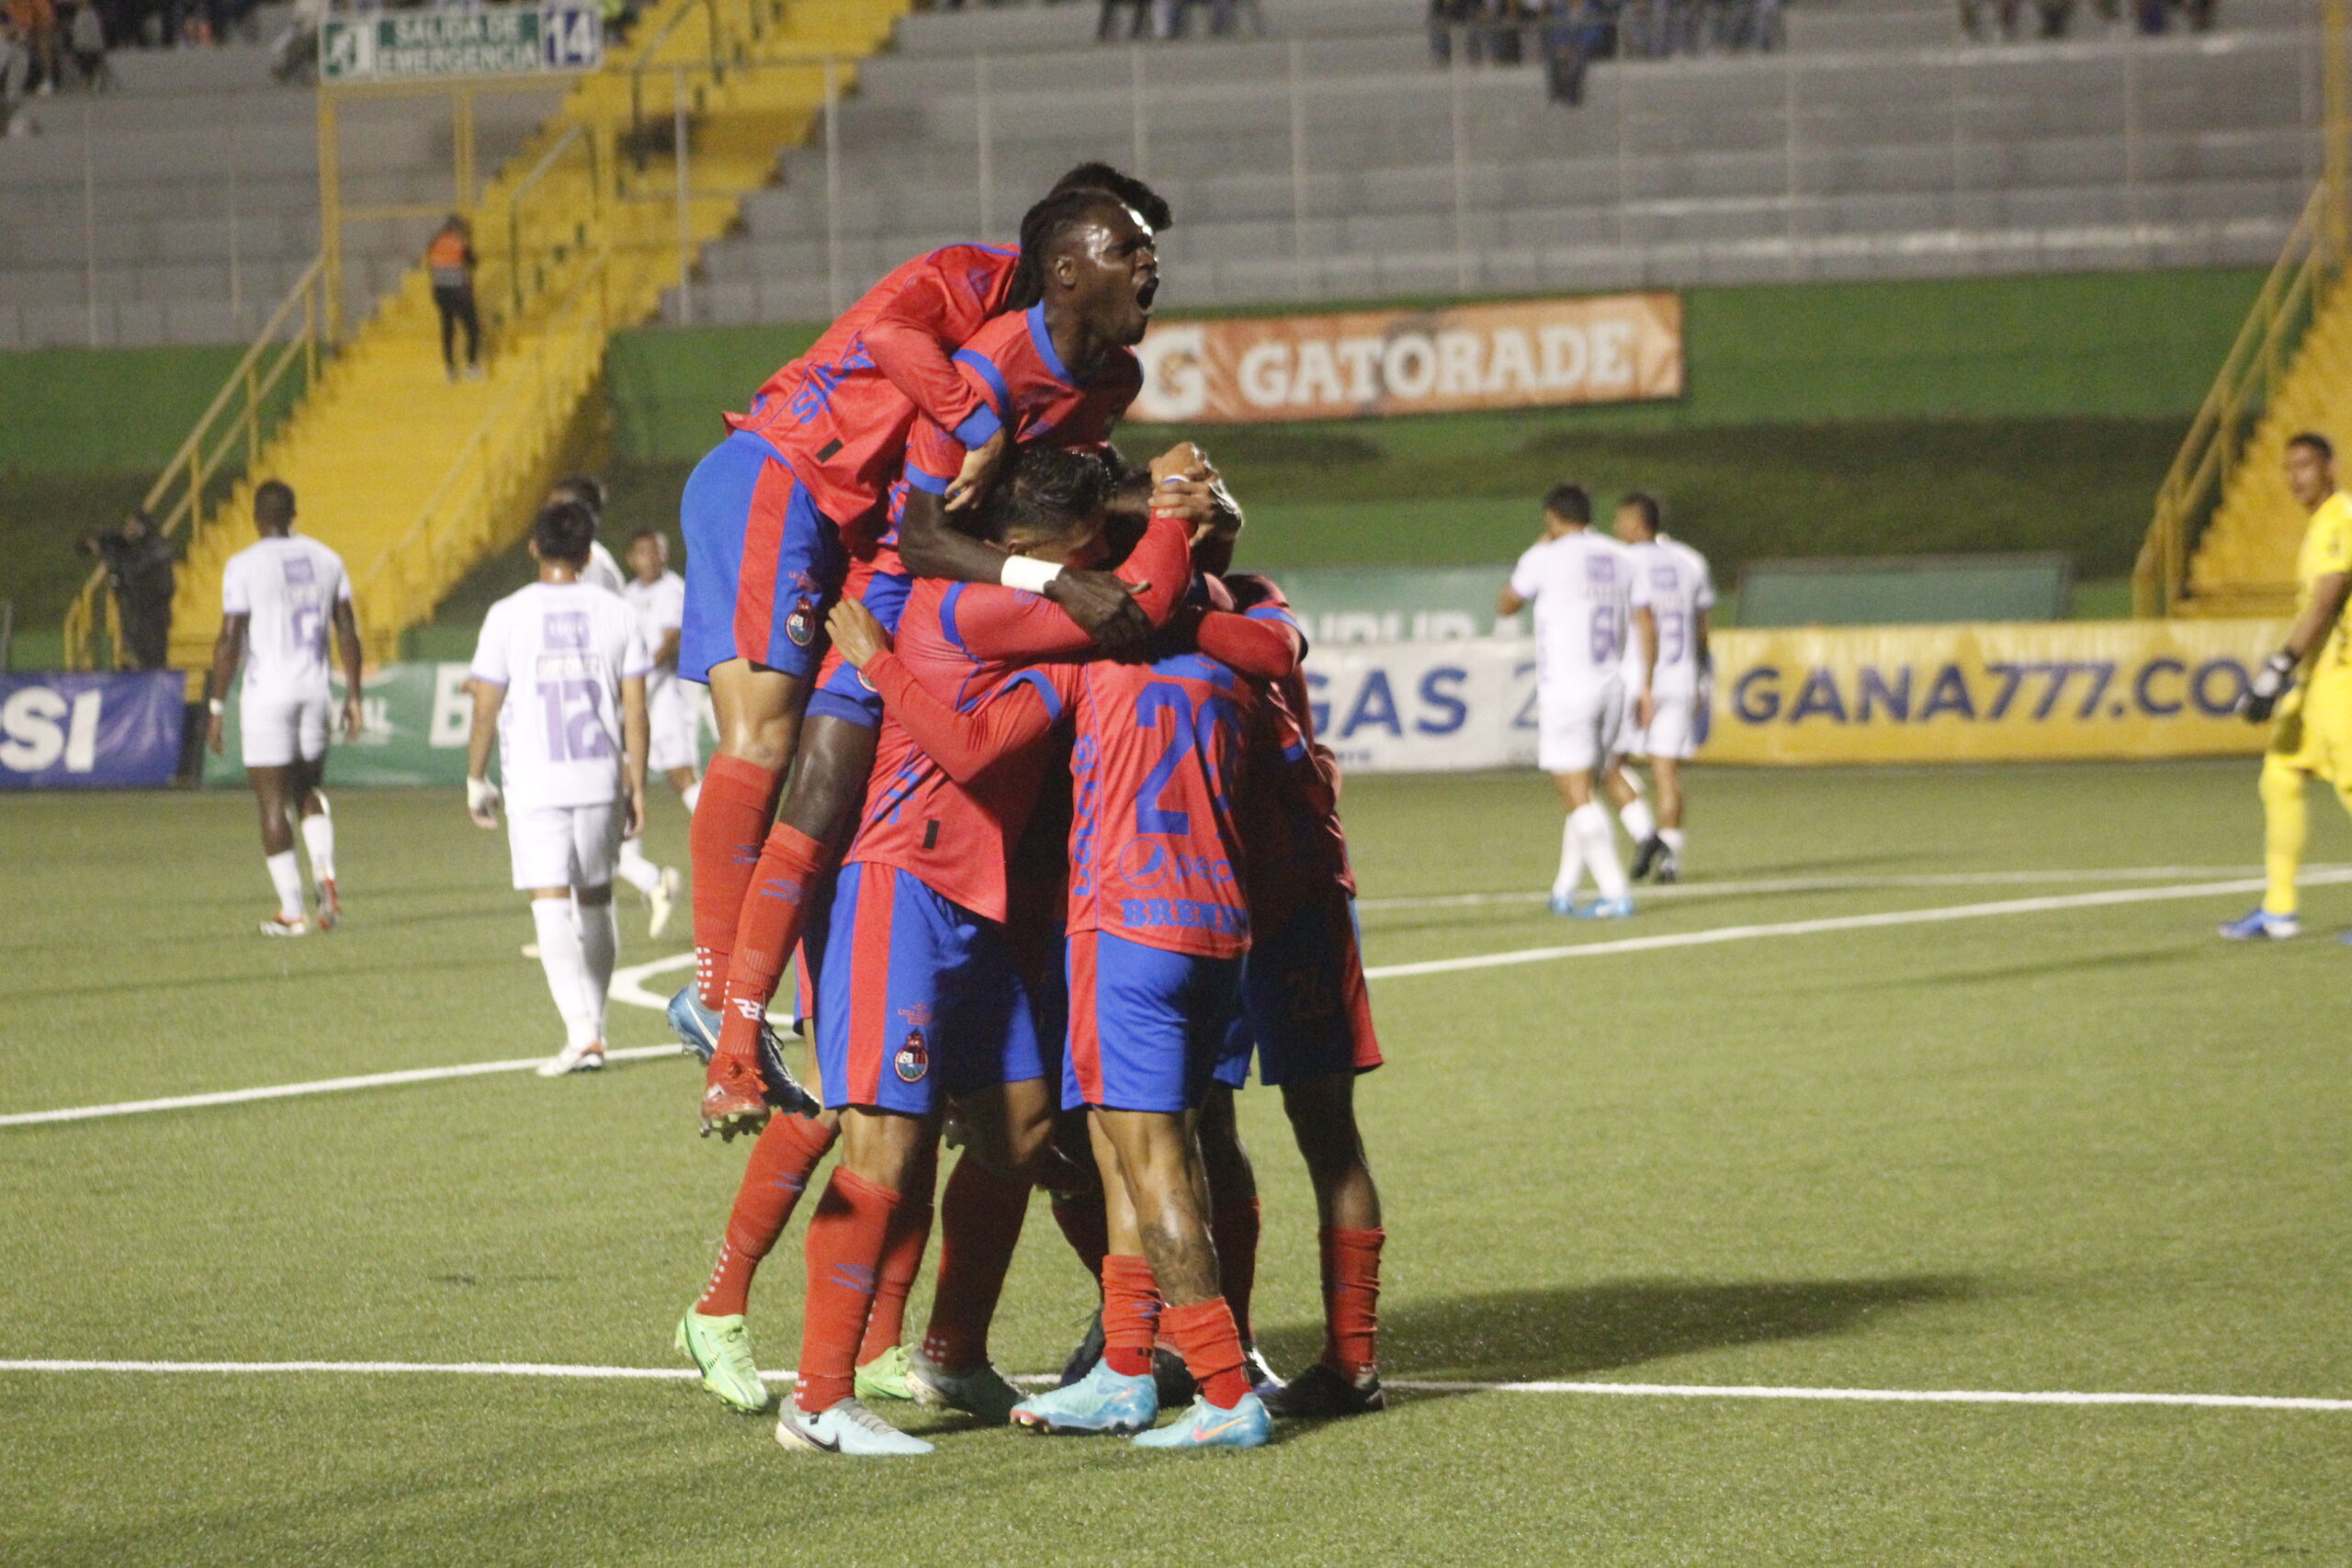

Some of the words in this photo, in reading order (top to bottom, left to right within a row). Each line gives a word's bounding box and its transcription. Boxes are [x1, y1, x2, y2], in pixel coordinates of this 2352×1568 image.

[395, 14, 481, 42] SALIDA
[490, 12, 521, 40] DE
[548, 11, 594, 66] 14
[378, 44, 538, 74] EMERGENCIA
[1238, 320, 1634, 407] GATORADE
[537, 678, 609, 761] 12
[1732, 659, 2251, 724] GANA777.CO
